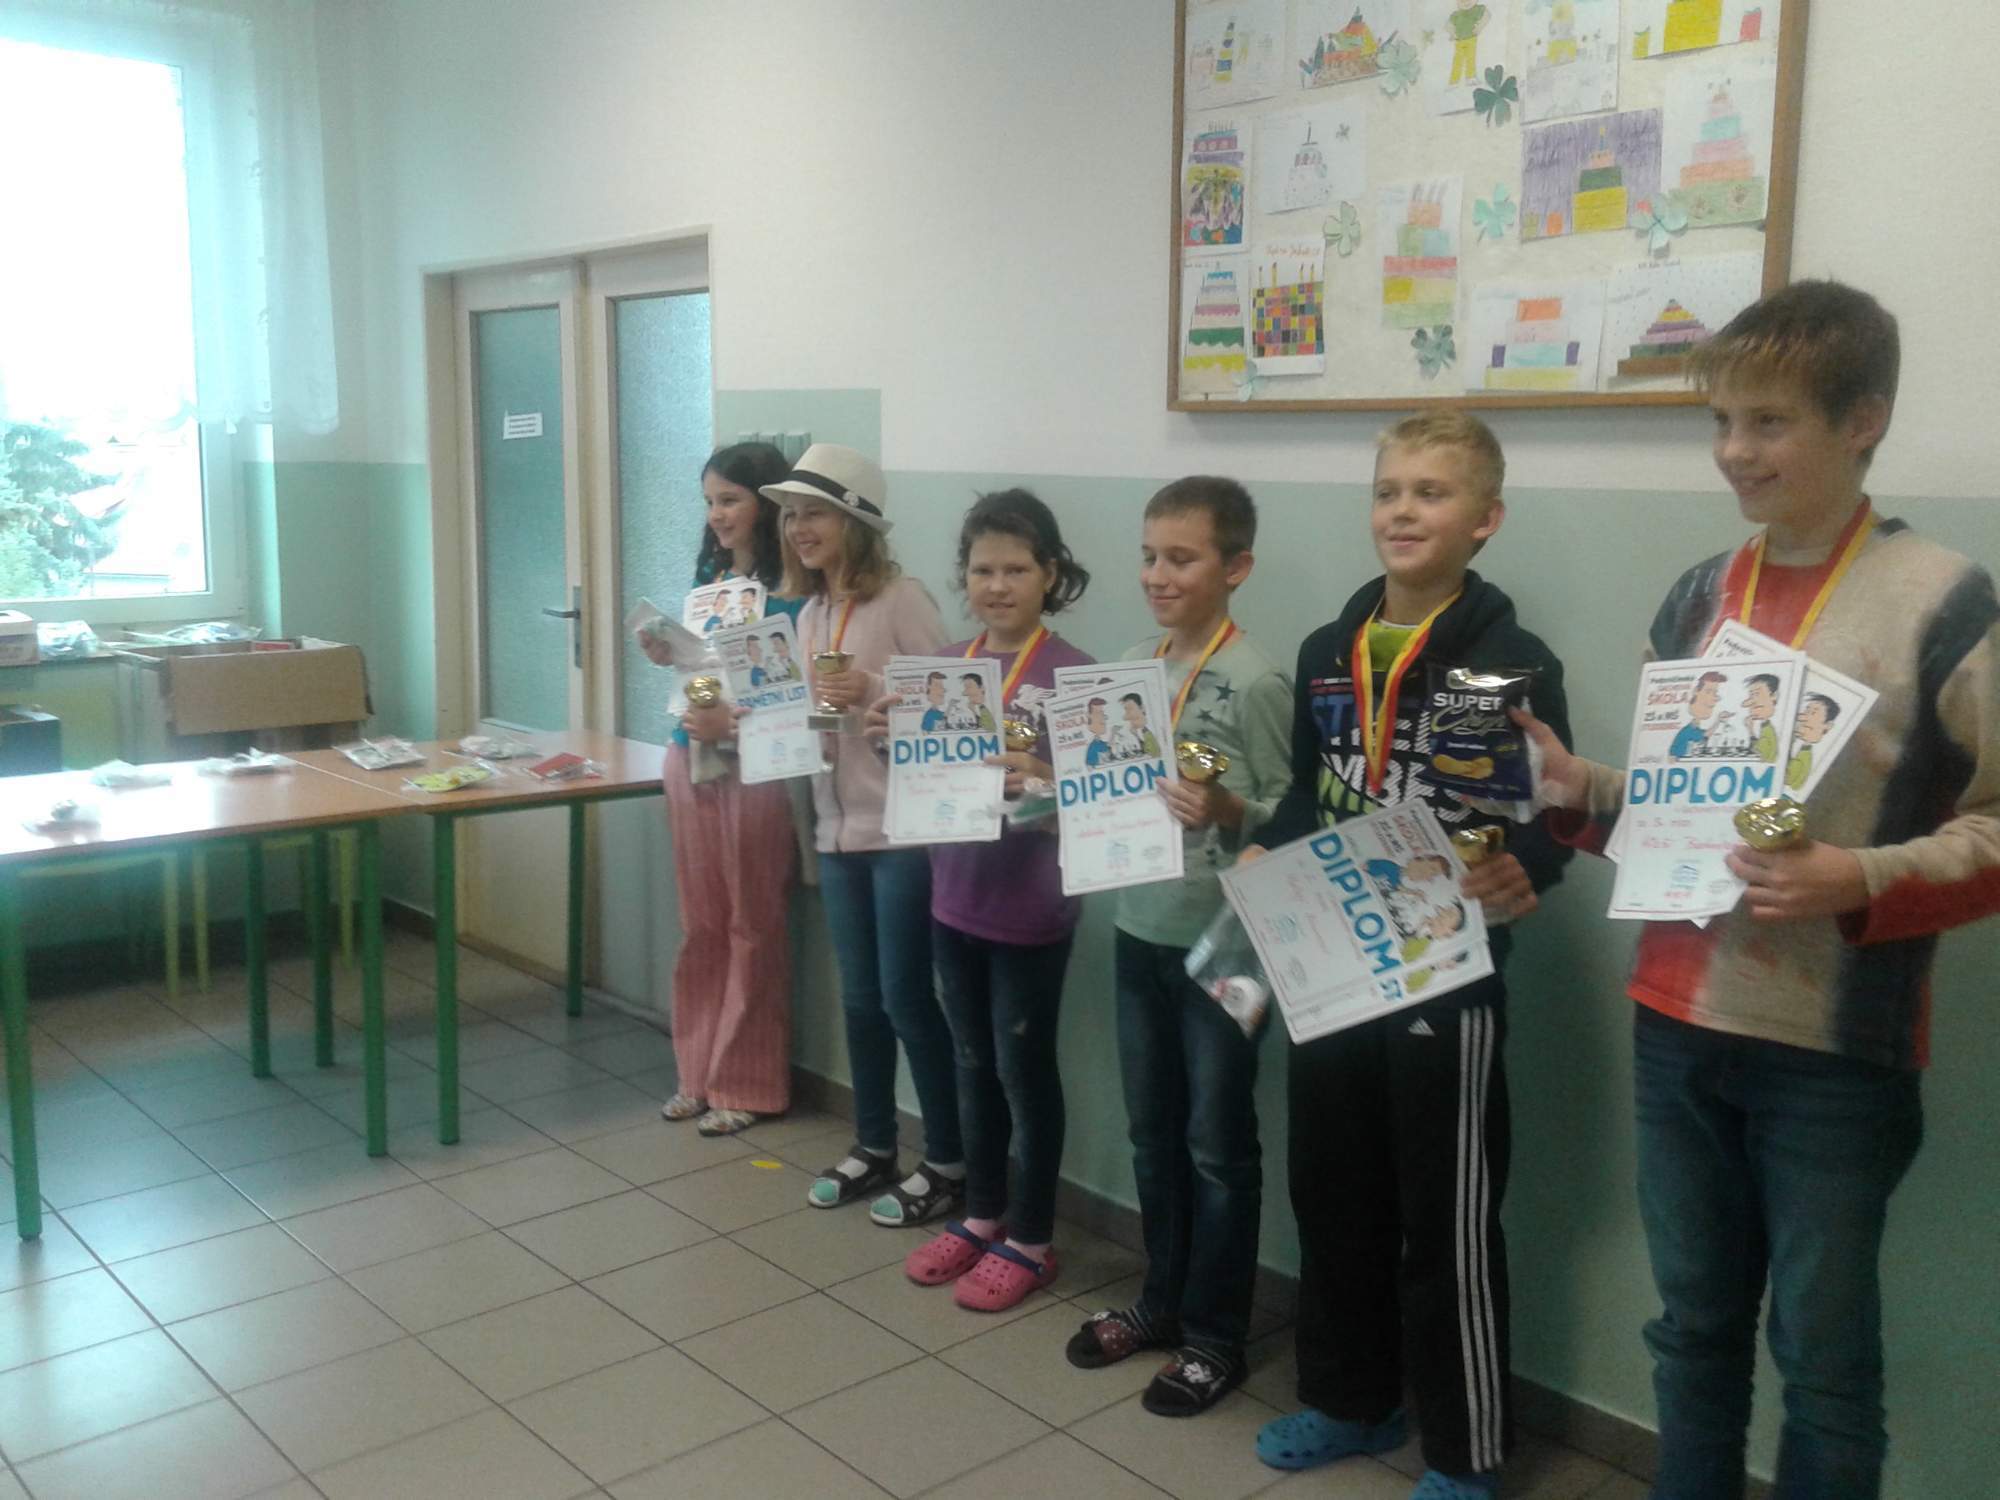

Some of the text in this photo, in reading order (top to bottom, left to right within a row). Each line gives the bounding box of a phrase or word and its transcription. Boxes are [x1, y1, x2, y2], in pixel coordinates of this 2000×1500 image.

[894, 734, 1000, 765] DIPLOM
[1060, 759, 1167, 808] DIPLOM
[1628, 766, 1776, 804] DIPLOM
[1309, 832, 1401, 975] DIPLOM
